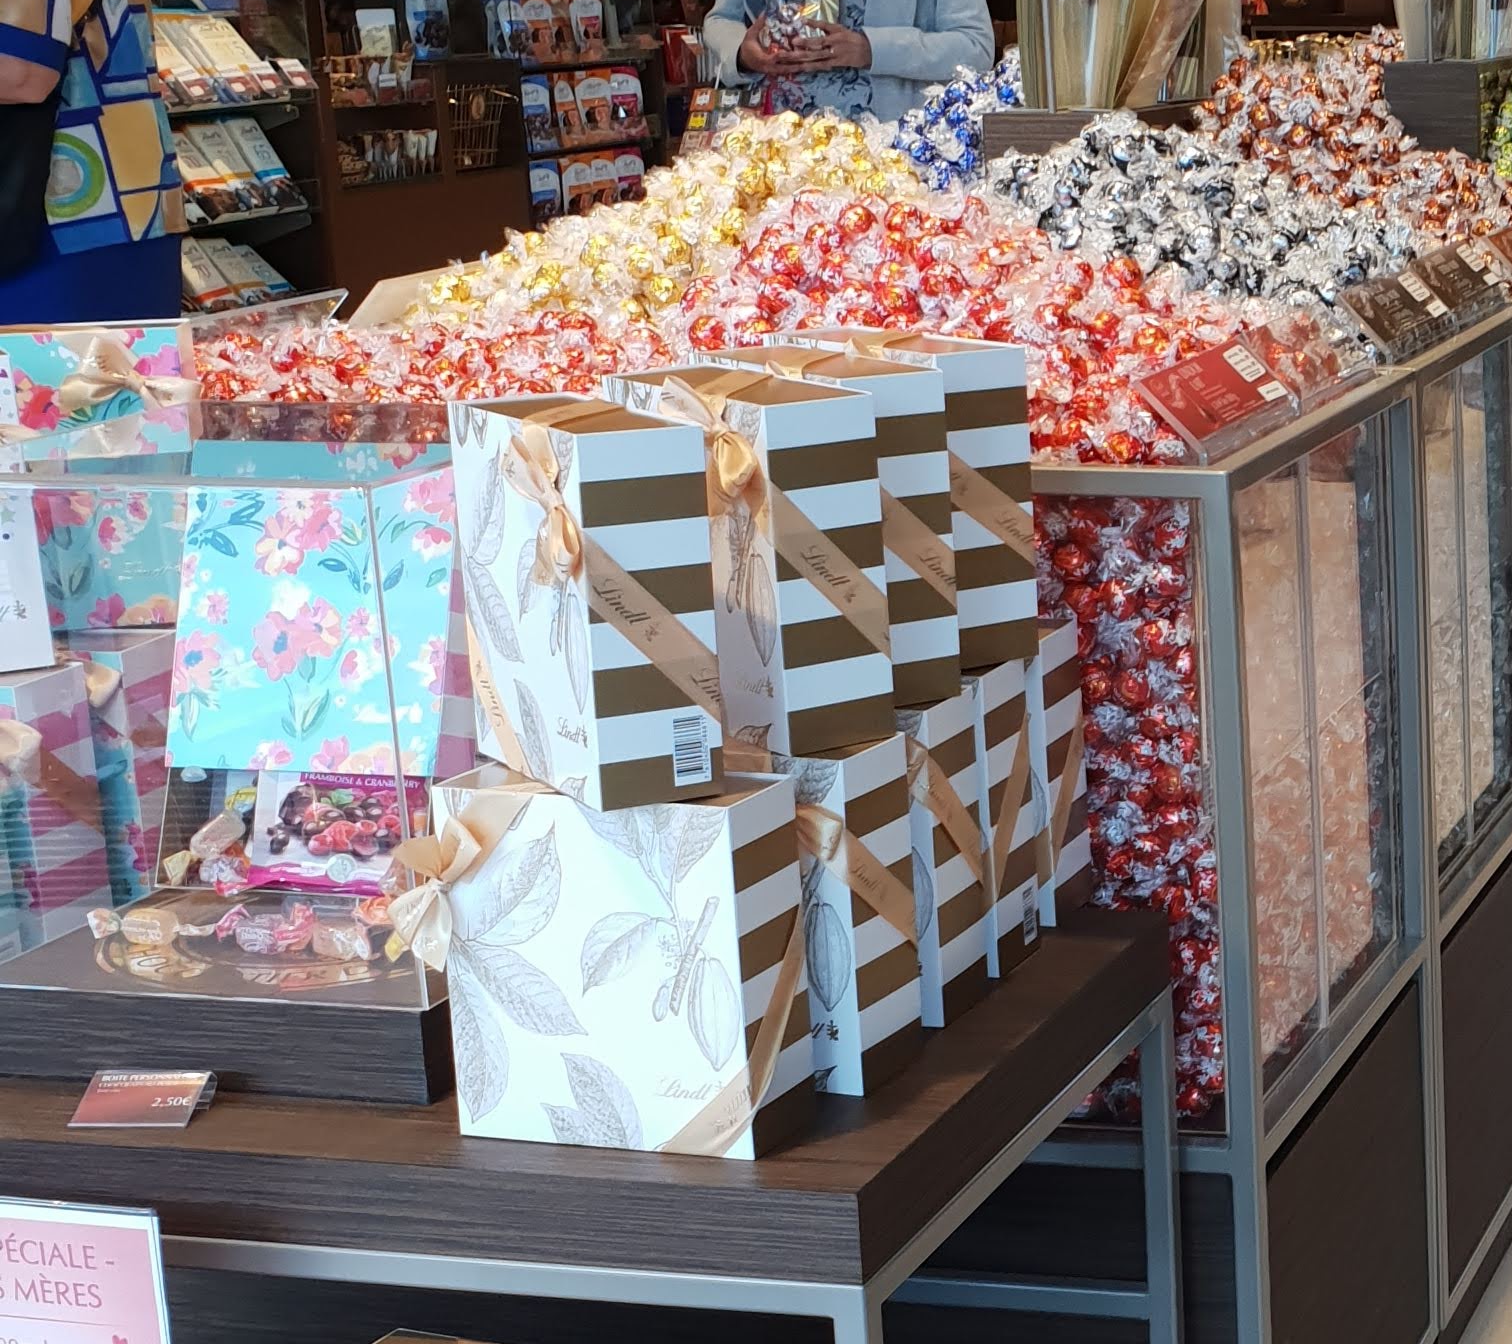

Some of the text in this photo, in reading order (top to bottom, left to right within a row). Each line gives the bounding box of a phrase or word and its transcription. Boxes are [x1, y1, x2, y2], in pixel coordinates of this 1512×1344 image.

[801, 543, 850, 588] Lindt
[592, 577, 651, 626] Lindt
[355, 777, 363, 786] &
[151, 1096, 192, 1108] 2,50€
[656, 1078, 713, 1100] Lindt
[15, 1273, 103, 1308] MÈRES
